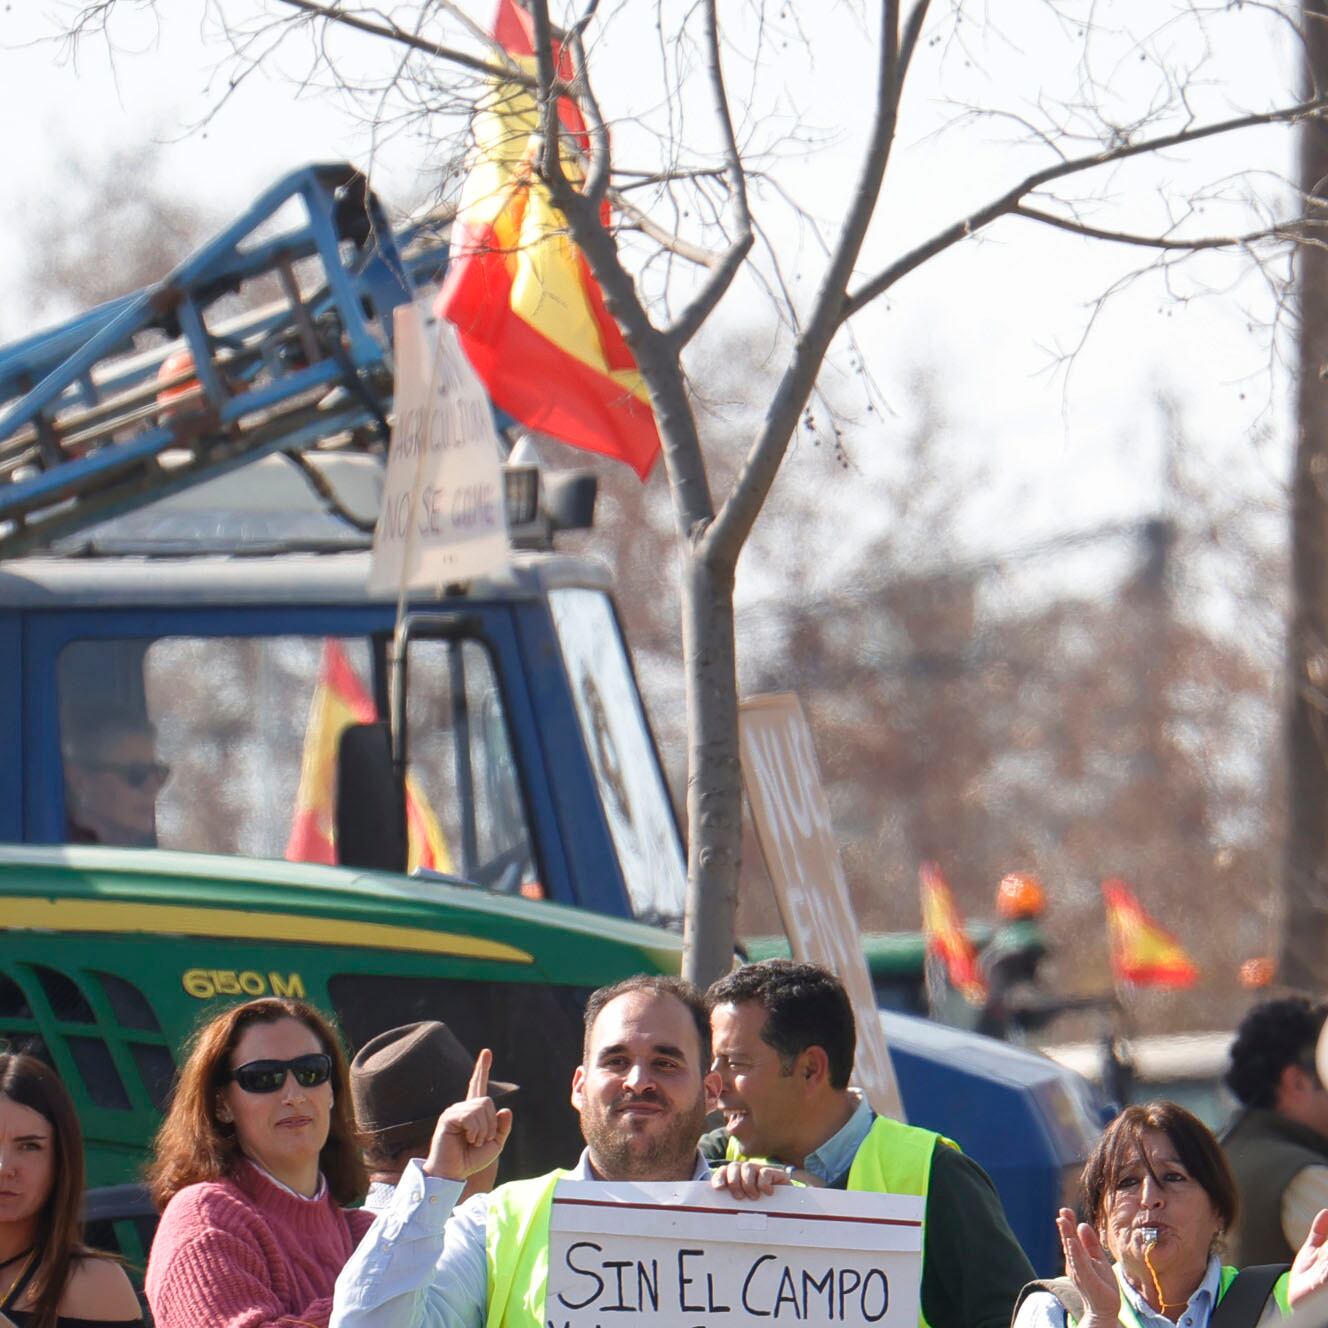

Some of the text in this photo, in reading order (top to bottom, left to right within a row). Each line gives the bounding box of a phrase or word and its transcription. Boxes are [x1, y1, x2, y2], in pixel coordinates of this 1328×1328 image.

[557, 1242, 889, 1322] SIN EL CAMPO
